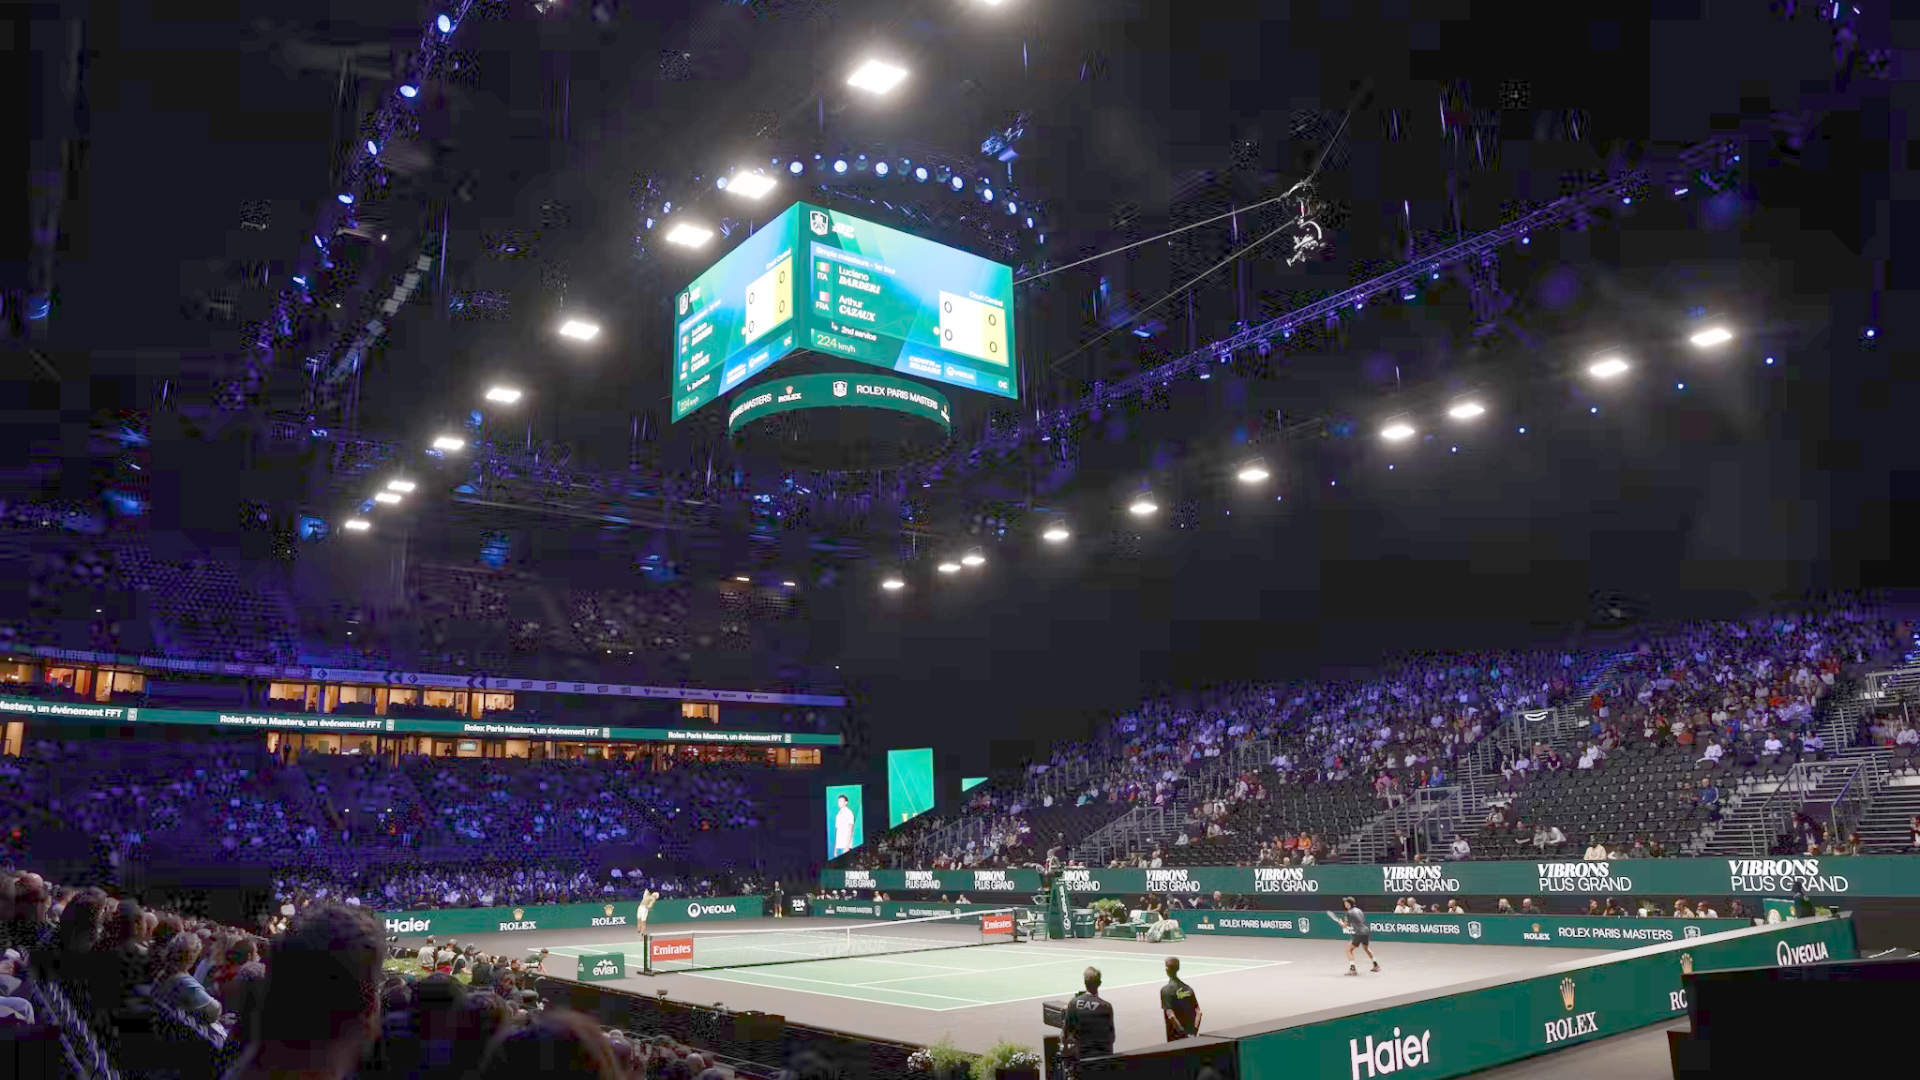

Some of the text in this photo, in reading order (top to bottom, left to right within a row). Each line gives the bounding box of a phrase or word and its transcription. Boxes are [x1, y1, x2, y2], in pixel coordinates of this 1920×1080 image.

[779, 271, 785, 284] 0
[817, 272, 828, 281] ITA
[839, 266, 869, 281] Luciano
[839, 276, 881, 294] DARDERI
[749, 292, 754, 305] 0
[839, 295, 863, 308] Arthur
[969, 290, 1003, 307] Court Central
[779, 300, 785, 313] 0
[815, 301, 829, 311] FRA
[944, 301, 952, 313] 0
[839, 305, 876, 322] CAZAUX
[989, 314, 996, 326] 0
[749, 320, 754, 333] 0
[841, 326, 877, 341] 2nd service
[945, 329, 953, 341] 0
[817, 334, 855, 353] 224 km/h
[989, 341, 997, 353] 0
[744, 393, 772, 410] MASTERS
[857, 385, 938, 410] ROLEX PARIS MASTERS
[51, 704, 103, 717] événement
[105, 708, 123, 718] FFT
[220, 714, 245, 724] Rolex
[246, 717, 267, 725] Paris
[268, 717, 305, 727] Masters,
[320, 718, 365, 728] événement
[366, 720, 382, 729] FFT
[464, 724, 485, 732] Rolex
[486, 725, 504, 733] Paris
[505, 725, 535, 735] Masters,
[547, 726, 585, 735] événement
[586, 728, 600, 736] FFT
[668, 731, 685, 739] Rolex
[686, 732, 701, 740] Paris
[703, 732, 729, 741] Masters,
[1254, 867, 1303, 880] VIBRONS
[1382, 865, 1442, 880] VIBRONS
[1537, 862, 1609, 878] VIBRONS
[1728, 859, 1819, 876] VIBRONS
[845, 871, 869, 880] VIBRONS
[905, 871, 933, 880] VIBRONS
[974, 870, 1005, 881] VIBRONS
[1146, 869, 1188, 881] VIBRONS
[845, 879, 876, 888] PLUS GRAND
[905, 880, 941, 889] PLUS GRAND
[974, 880, 1014, 890] PLUS GRAND
[1073, 881, 1100, 891] GRAND
[1146, 881, 1200, 892] PLUS GRAND
[1255, 880, 1318, 892] PLUS GRAND
[1384, 879, 1460, 892] PLUS GRAND
[1539, 877, 1632, 892] PLUS GRAND
[1730, 875, 1849, 892] PLUS GRAND
[702, 905, 736, 914] VEOLIA
[385, 917, 430, 932] Haier
[499, 921, 536, 931] ROLEX
[592, 916, 626, 926] ROLEX
[984, 920, 1012, 930] Emirates
[1219, 919, 1292, 929] ROLEX PARIS MASTERS
[1370, 922, 1460, 934] ROLEX PARIS MASTERS
[1558, 927, 1674, 940] ROLEX PARIS MASTERS
[1523, 932, 1551, 941] ROLEX
[653, 944, 691, 956] Emirates
[1791, 941, 1829, 965] VEOLIA
[593, 965, 618, 976] evian
[1076, 1000, 1100, 1011] EA7
[1544, 1011, 1598, 1044] ROLEX
[1350, 1026, 1430, 1080] Haier
